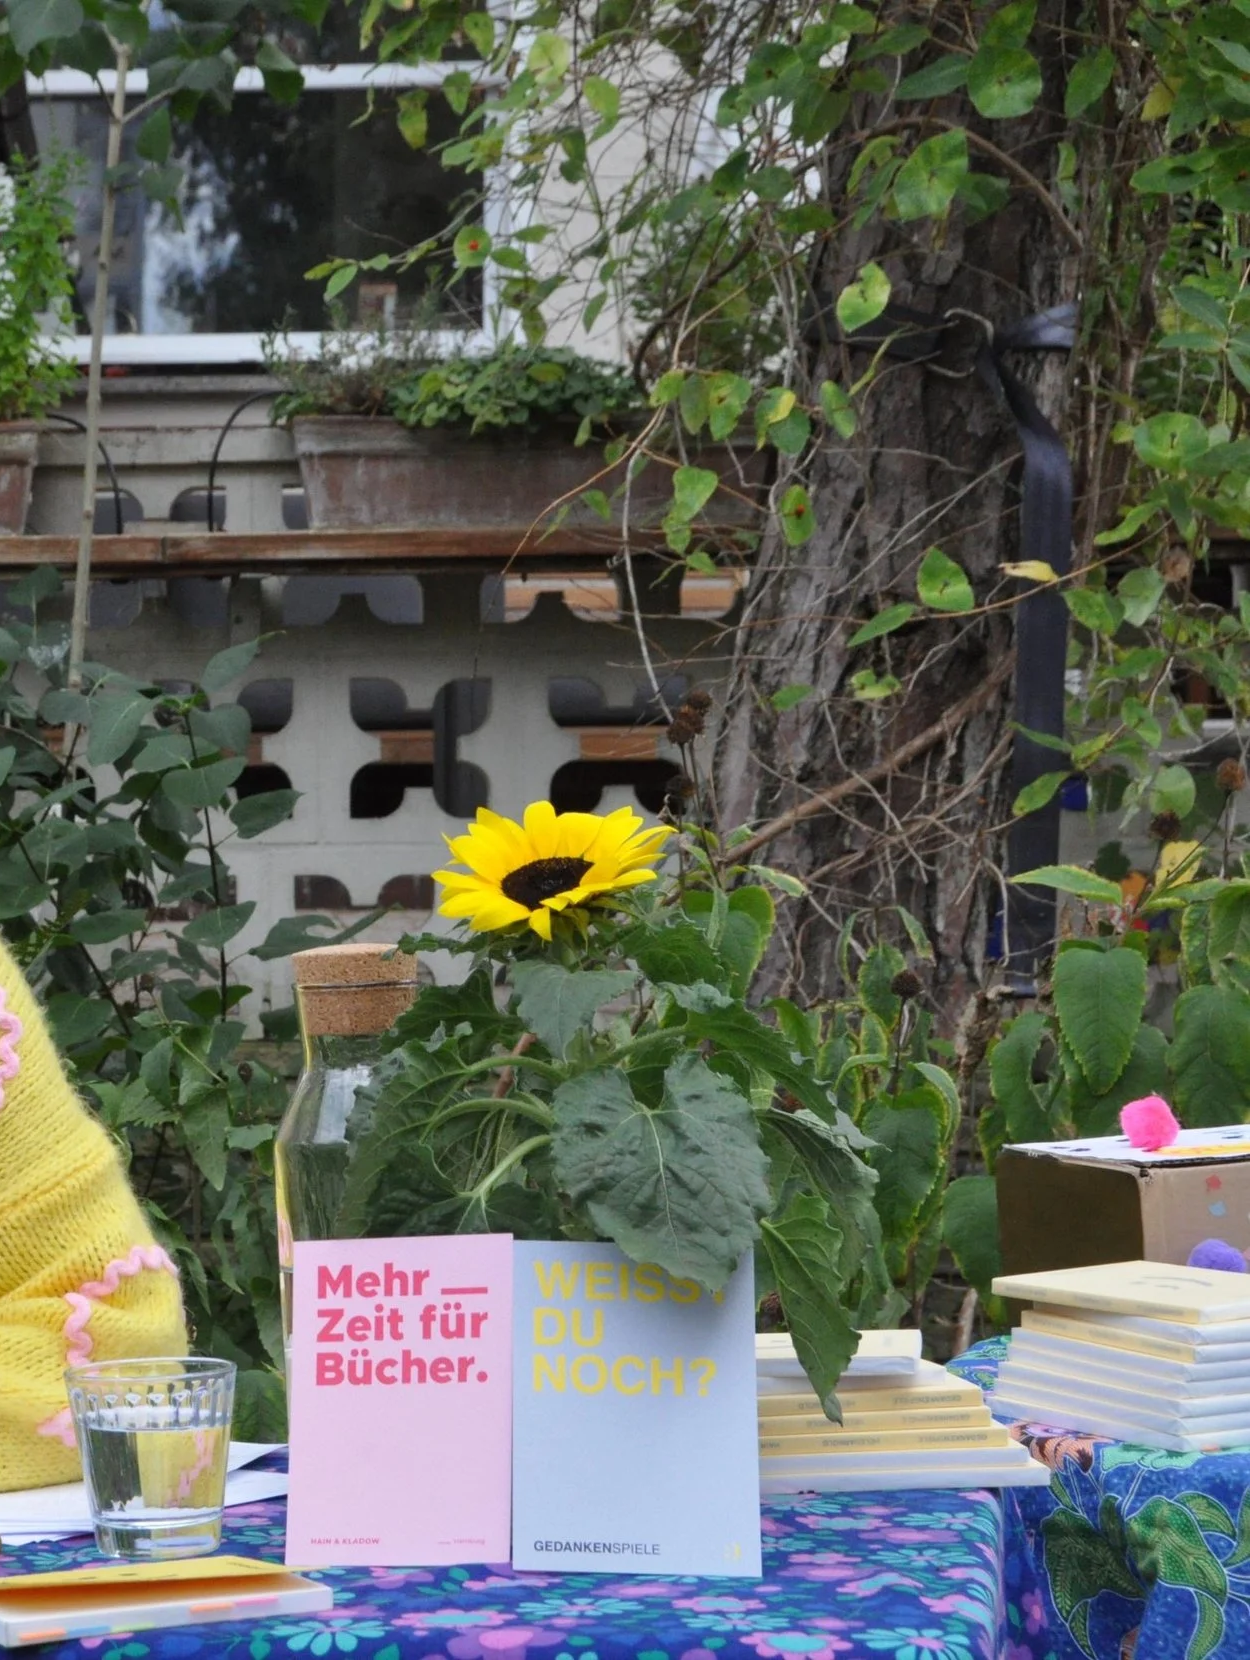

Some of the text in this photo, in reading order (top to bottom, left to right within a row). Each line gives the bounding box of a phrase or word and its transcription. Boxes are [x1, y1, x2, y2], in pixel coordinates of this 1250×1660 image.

[317, 1262, 430, 1299] Mehr
[534, 1260, 726, 1305] WEISS
[316, 1302, 488, 1342] Zeit für
[535, 1307, 604, 1347] DU
[316, 1348, 488, 1386] Bücher.
[533, 1353, 717, 1396] NOCH?
[310, 1537, 332, 1545] HAIN
[342, 1537, 380, 1545] KLADOW
[533, 1539, 661, 1556] GEDANKENSPIELE
